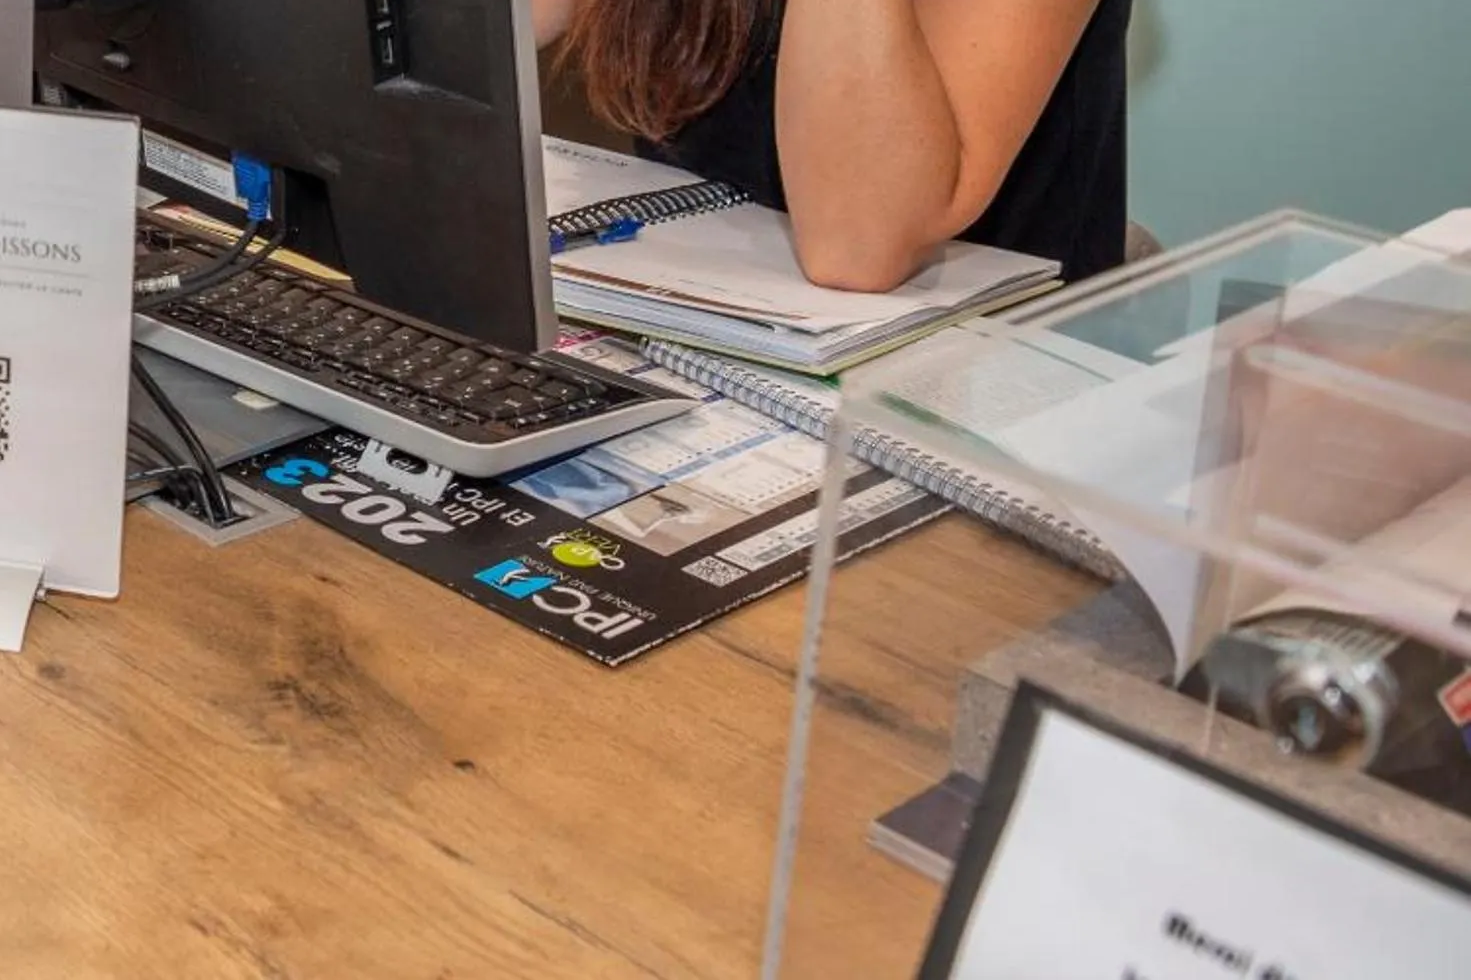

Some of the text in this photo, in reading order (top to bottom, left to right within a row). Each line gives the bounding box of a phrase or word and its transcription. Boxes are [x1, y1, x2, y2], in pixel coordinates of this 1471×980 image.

[264, 458, 456, 545] 2023
[455, 487, 507, 514] IPC
[442, 502, 482, 527] Un
[500, 508, 536, 527] Et
[532, 585, 644, 640] IPC
